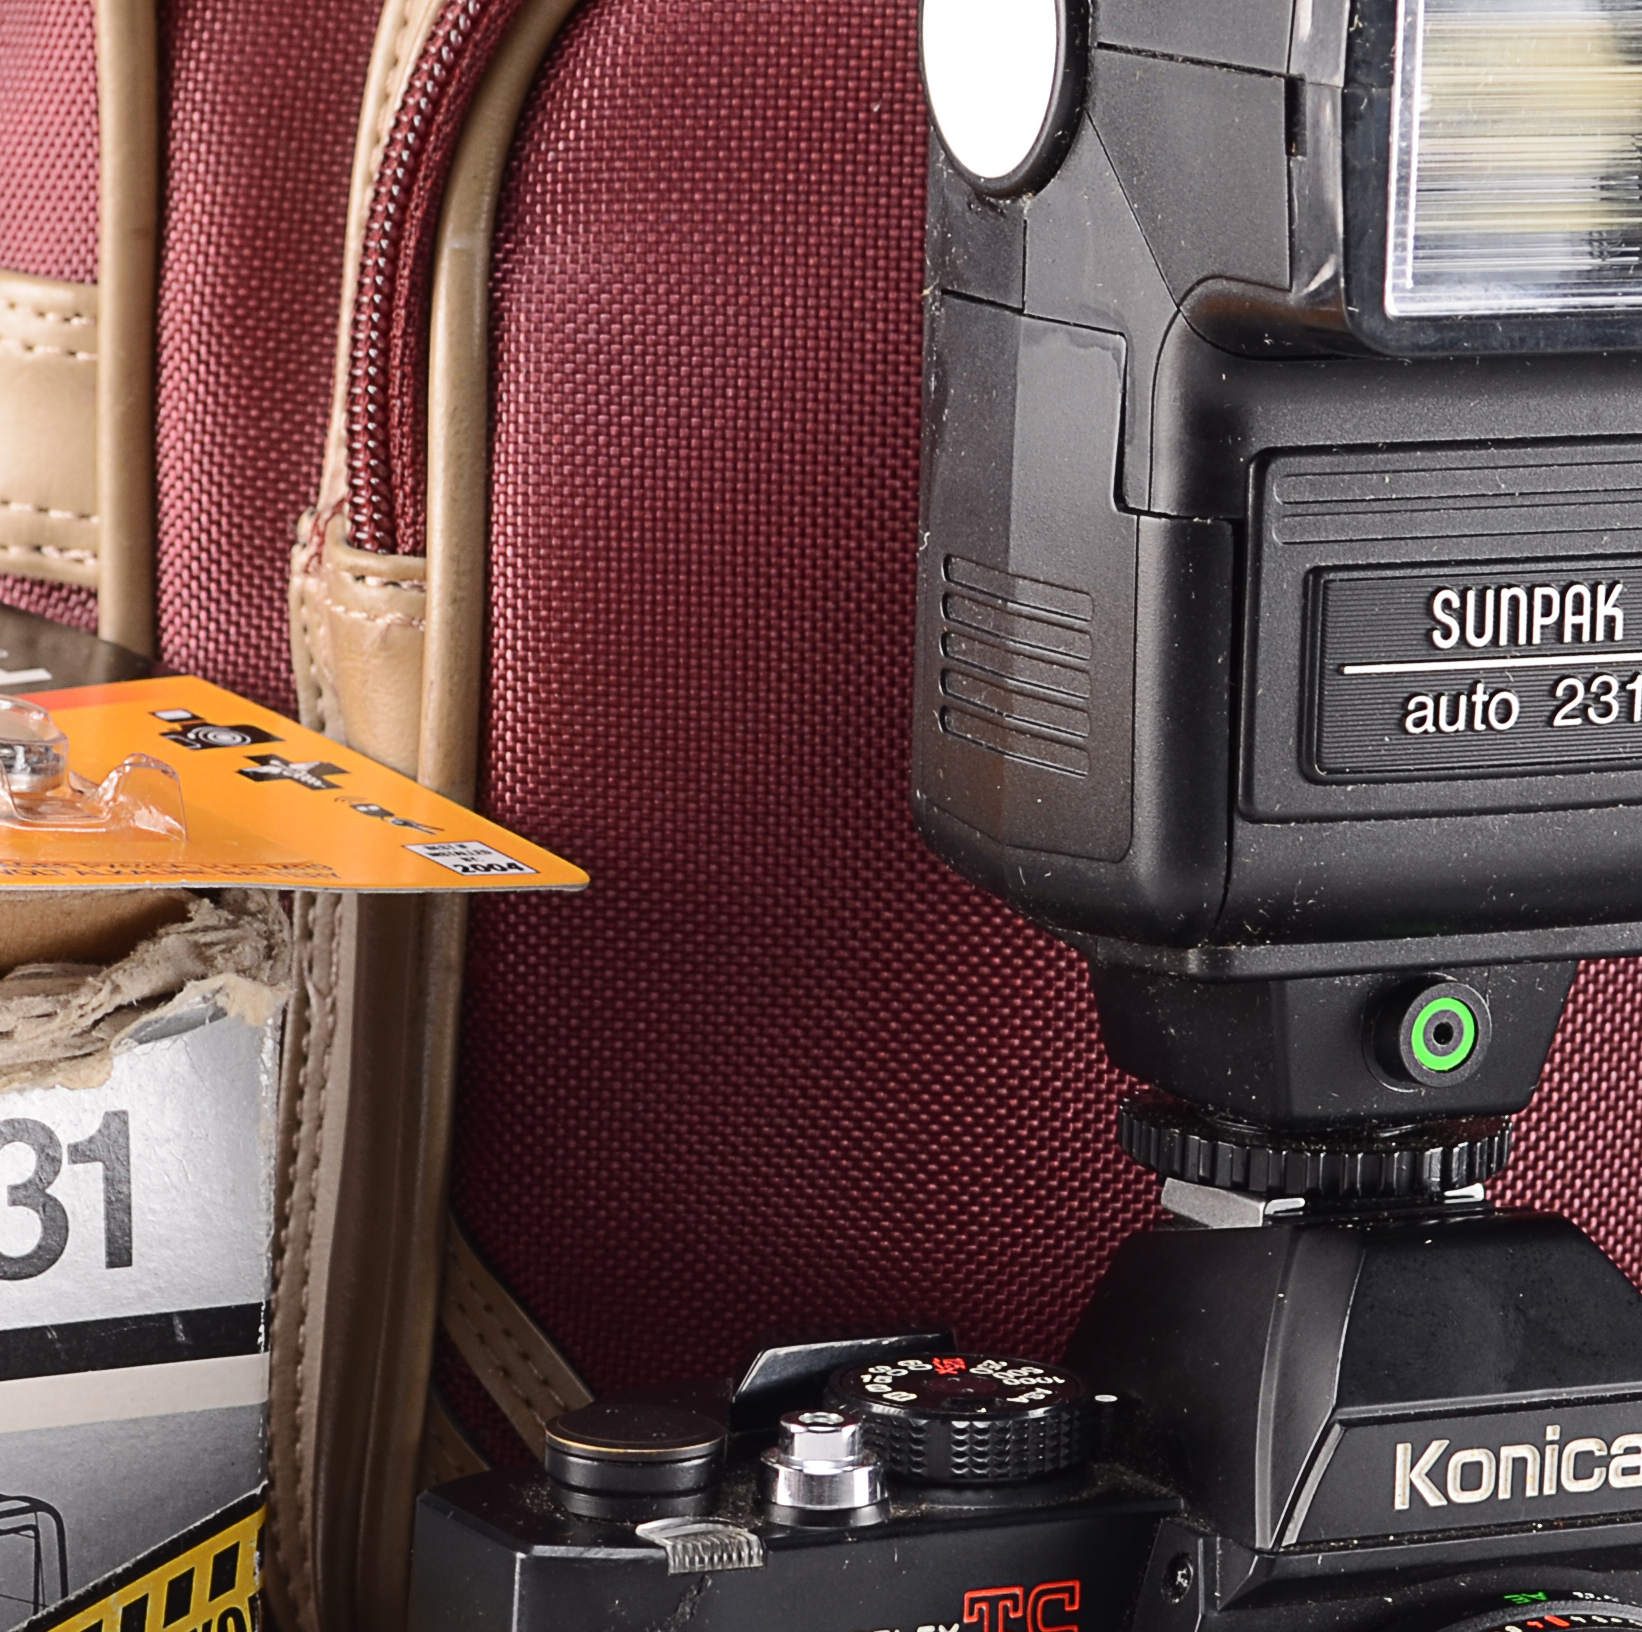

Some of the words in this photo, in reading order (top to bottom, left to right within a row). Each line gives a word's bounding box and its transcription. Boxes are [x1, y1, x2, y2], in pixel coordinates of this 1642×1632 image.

[1430, 580, 1625, 650] SUNPAK
[1403, 680, 1521, 735] auto
[453, 862, 525, 873] 2004
